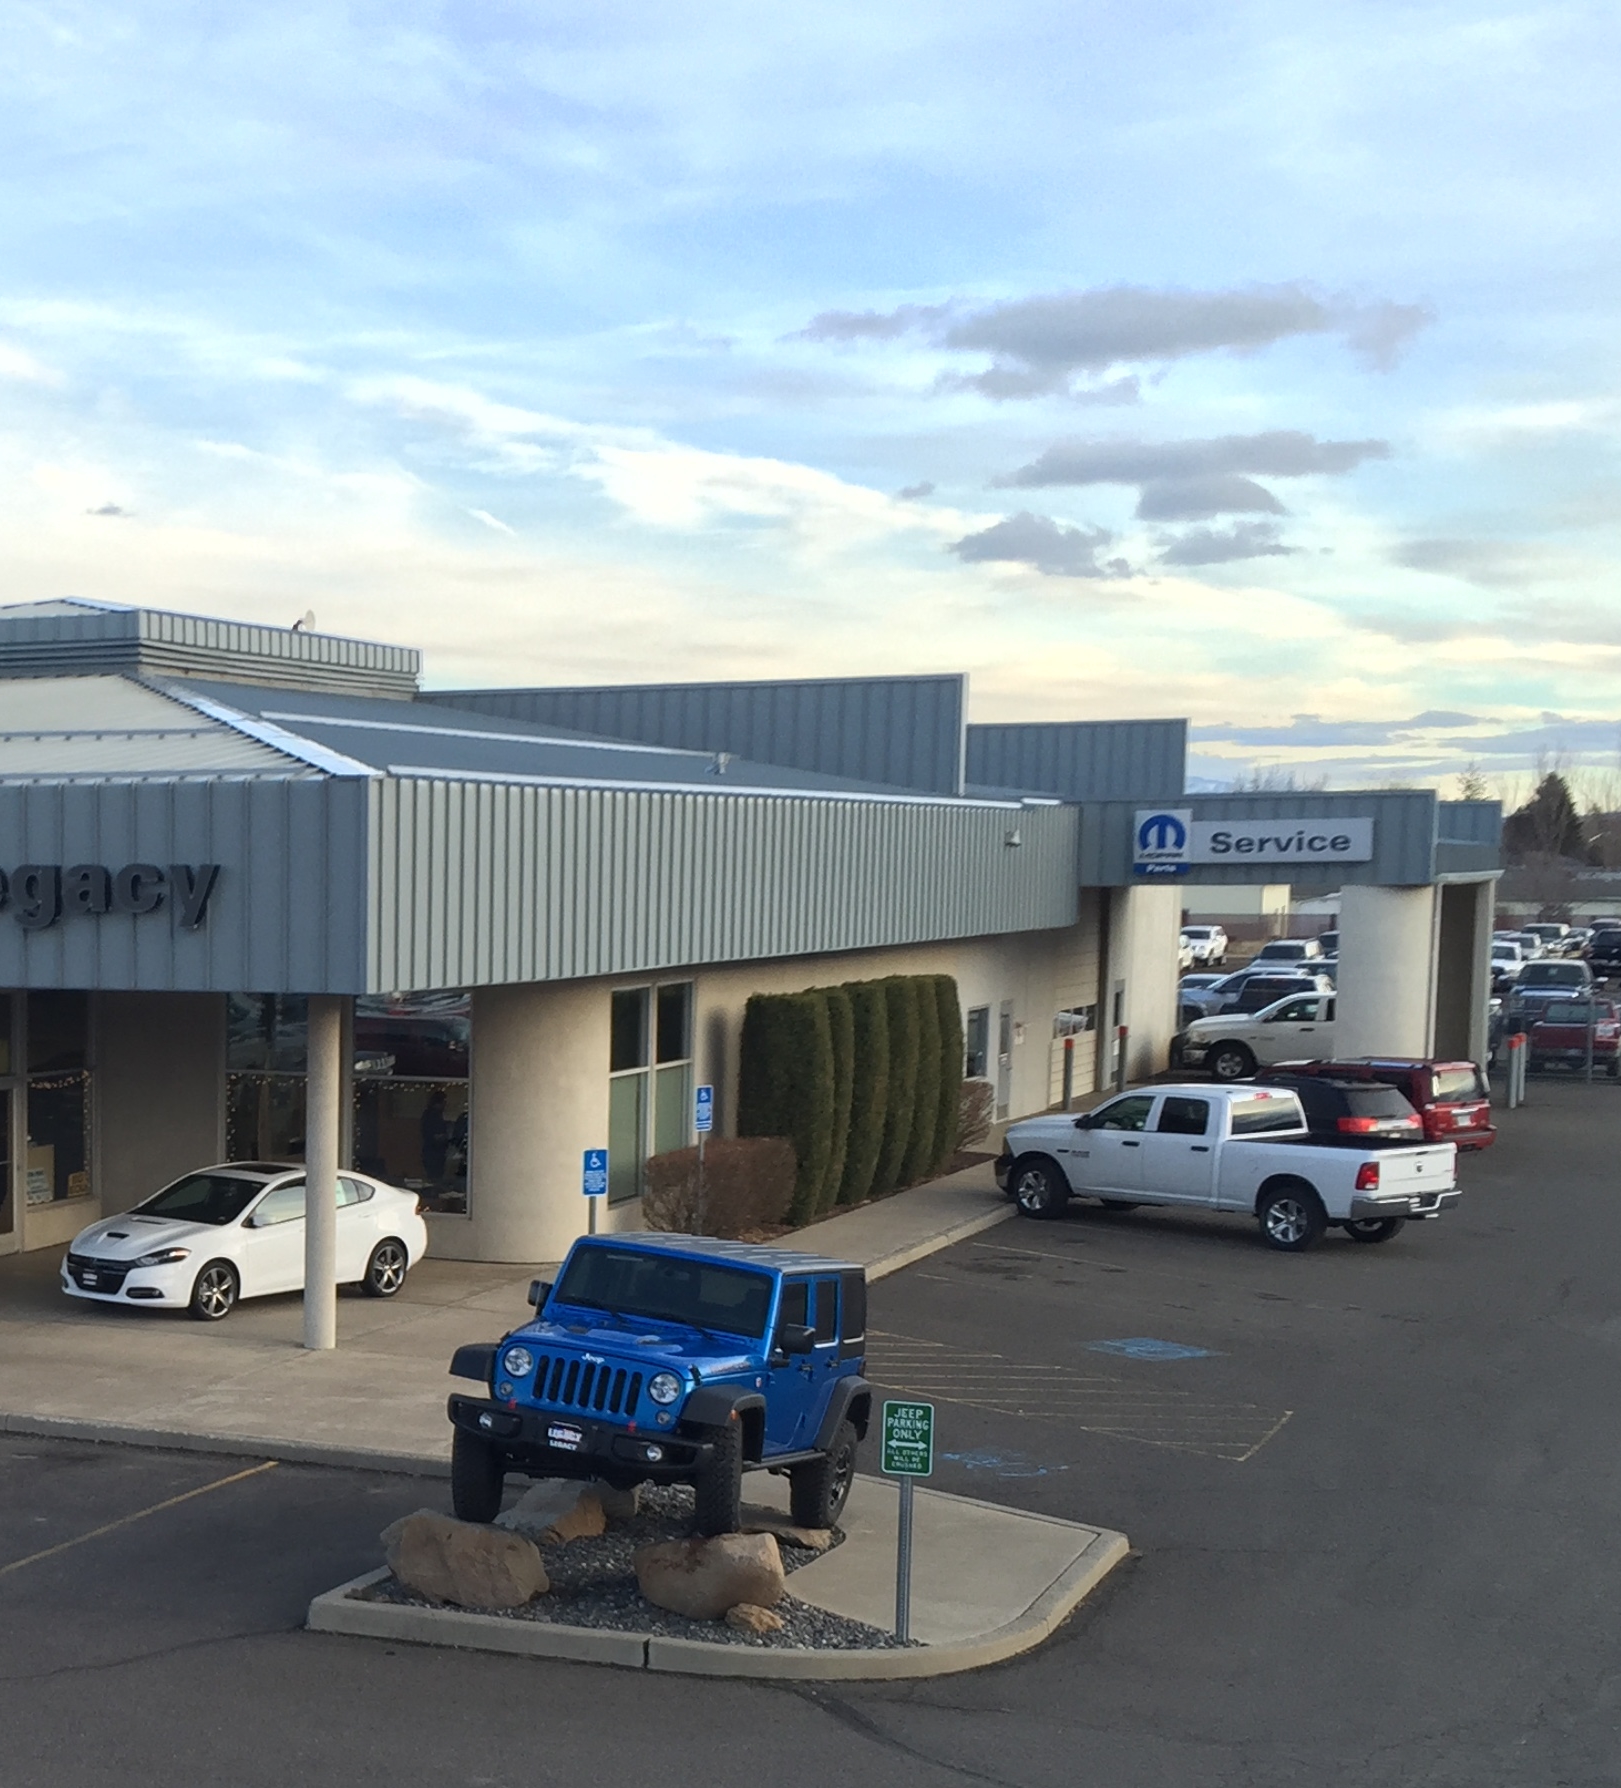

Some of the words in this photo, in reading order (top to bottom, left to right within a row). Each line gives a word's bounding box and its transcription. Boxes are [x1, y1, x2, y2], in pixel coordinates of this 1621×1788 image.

[1210, 830, 1351, 854] Service
[894, 1408, 923, 1419] JEEP
[887, 1417, 929, 1431] PARKING
[892, 1428, 923, 1439] ONLY
